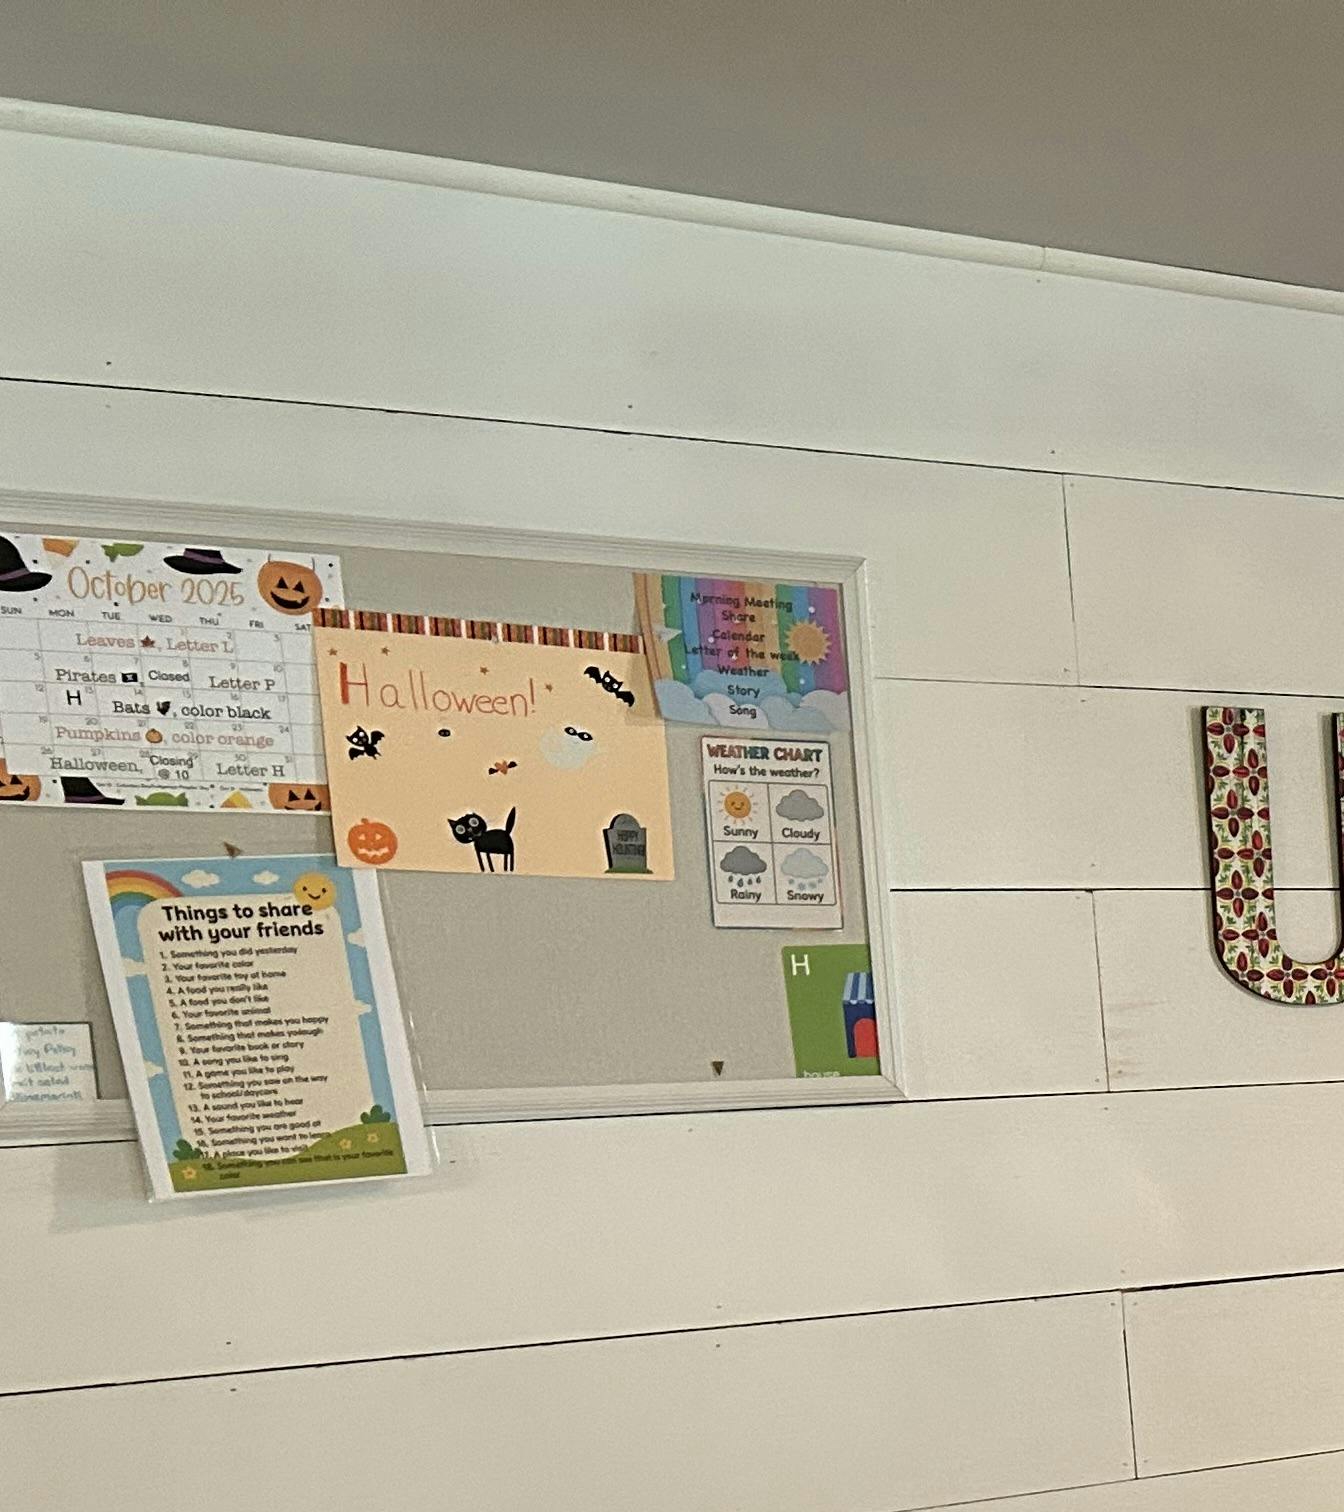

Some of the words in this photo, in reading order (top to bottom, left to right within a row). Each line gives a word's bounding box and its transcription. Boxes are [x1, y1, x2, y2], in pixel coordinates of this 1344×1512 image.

[68, 566, 172, 605] October
[181, 578, 245, 606] 2025
[691, 592, 740, 608] Morning
[744, 598, 793, 612] Meeting
[1, 606, 21, 614] SUN
[102, 612, 121, 620] TUE
[150, 614, 172, 622] WED
[200, 617, 219, 625] THU
[249, 620, 264, 628] FRI
[722, 612, 755, 622] Share
[76, 633, 134, 648] Leaves
[166, 638, 218, 653] Letter
[223, 641, 234, 653] L
[712, 630, 765, 641] Calendar
[728, 647, 739, 657] of
[746, 649, 765, 659] the
[770, 652, 800, 661] week
[718, 665, 770, 677] Weather
[56, 669, 116, 683] Pirates
[149, 671, 189, 681] Closed
[209, 676, 260, 689] Letter
[265, 679, 275, 690] P
[67, 690, 82, 705] H
[339, 662, 536, 718] Halloween!
[728, 685, 760, 698] Story
[113, 701, 150, 714] Bats
[181, 705, 223, 718] color
[227, 706, 271, 719] black
[729, 705, 757, 719] Song
[56, 726, 141, 742] Pumpkins
[173, 733, 214, 744] color
[218, 735, 274, 748] orange
[707, 744, 769, 760] WEATHER
[774, 746, 822, 762] CHART
[50, 758, 143, 773] Halloween,
[217, 764, 267, 776] Letter
[272, 765, 285, 777] H
[150, 755, 193, 768] Closing
[177, 771, 189, 779] 10
[714, 764, 745, 775] How's
[750, 766, 766, 776] the
[770, 768, 819, 778] weather?
[724, 826, 758, 839] Sunny
[782, 828, 820, 841] Cloudy
[731, 889, 761, 902] Rainy
[787, 890, 824, 902] Snowy
[162, 906, 228, 923] Things
[233, 904, 253, 918] to
[259, 902, 313, 917] share
[159, 926, 202, 942] with
[208, 927, 251, 943] your
[257, 921, 323, 937] friends
[171, 950, 218, 959] Something
[222, 950, 237, 958] you
[256, 947, 297, 956] yesterday
[790, 954, 810, 976] H
